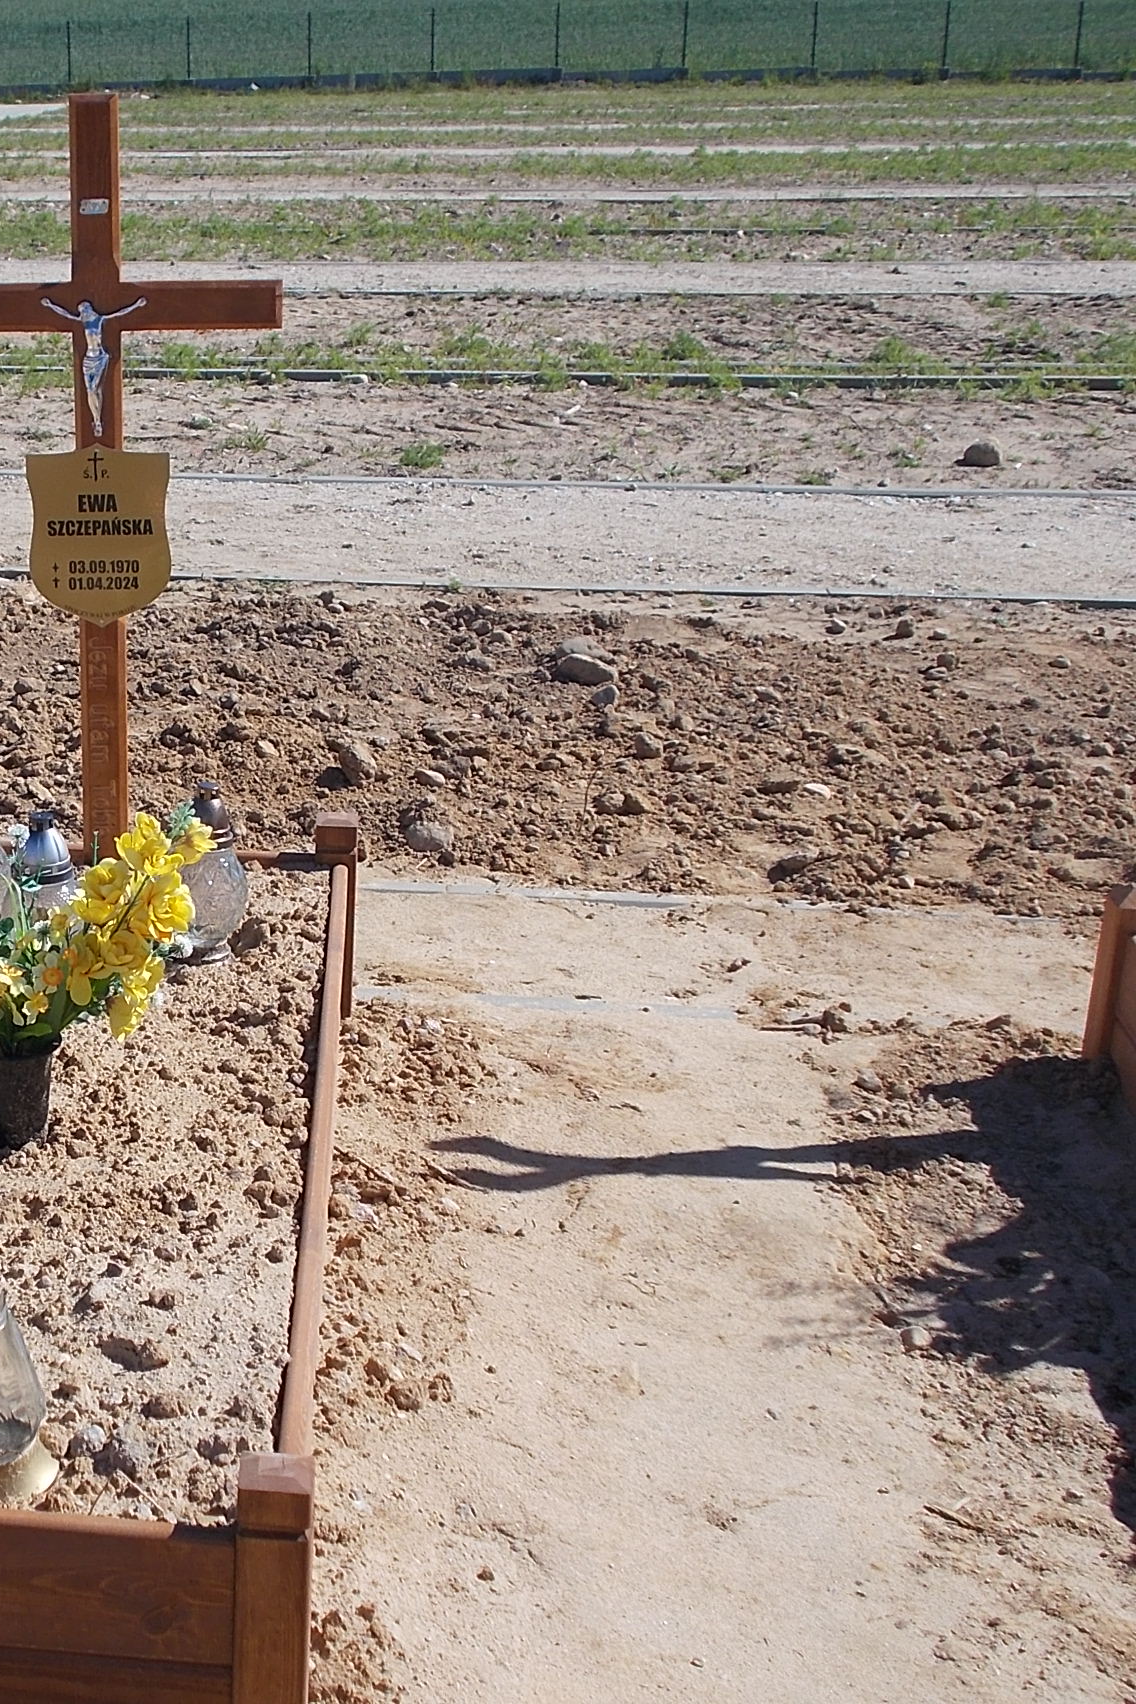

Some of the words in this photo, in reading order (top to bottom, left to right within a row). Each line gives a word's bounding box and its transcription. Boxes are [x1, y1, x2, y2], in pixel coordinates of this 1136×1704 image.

[78, 494, 118, 512] EWA
[47, 516, 154, 537] SZCZEPAŃSKA
[68, 560, 140, 574] 03.09.1970
[68, 577, 139, 590] 01.04.2024
[89, 636, 114, 688] Jezu
